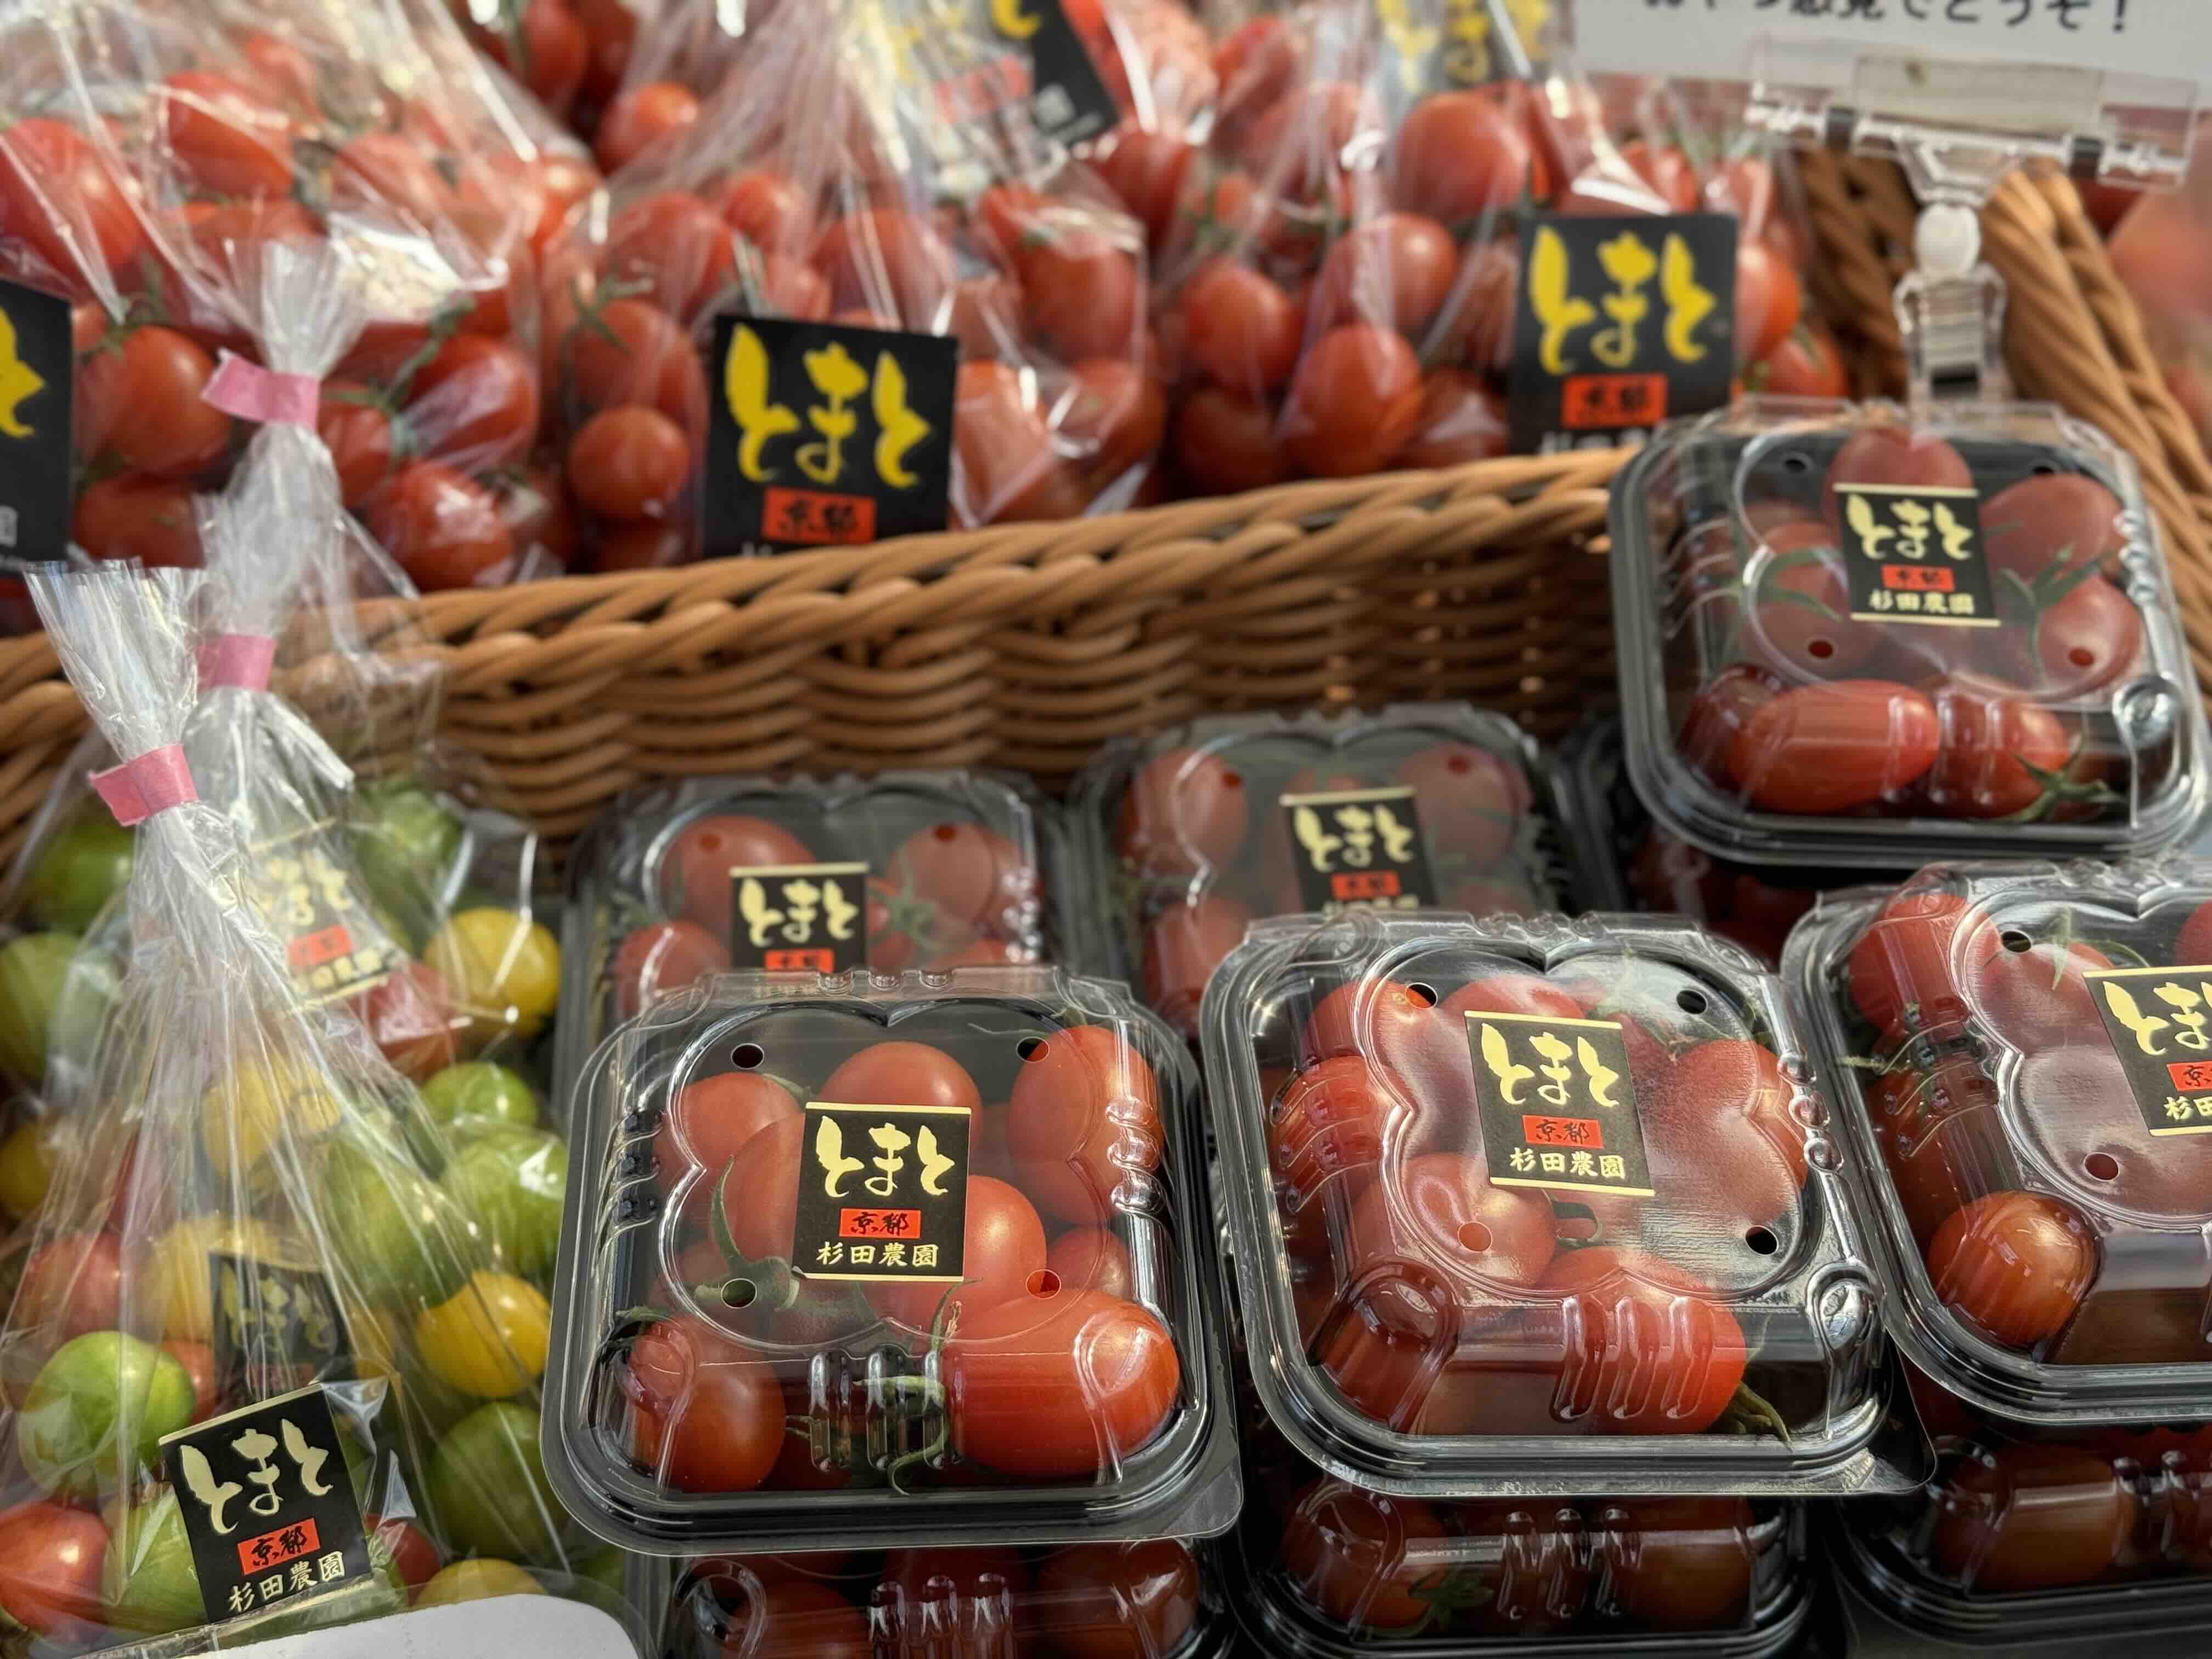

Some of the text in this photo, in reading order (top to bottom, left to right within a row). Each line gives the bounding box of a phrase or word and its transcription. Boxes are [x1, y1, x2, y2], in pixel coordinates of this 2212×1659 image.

[1530, 225, 1717, 375] とまと
[724, 325, 931, 488] とまと
[1847, 494, 1973, 560] とまと
[1294, 803, 1414, 873] とまと
[740, 877, 859, 947] とまと
[1481, 1022, 1620, 1108] とまと
[815, 1114, 955, 1198] とまと
[1509, 1147, 1626, 1180] 杉田農園
[1536, 1119, 1590, 1144] 京都
[816, 1241, 939, 1268] 杉田農園
[850, 1212, 910, 1235] 京都
[179, 1418, 334, 1535] とまと
[250, 1525, 308, 1566] 京都
[228, 1550, 345, 1613] 杉田農園
